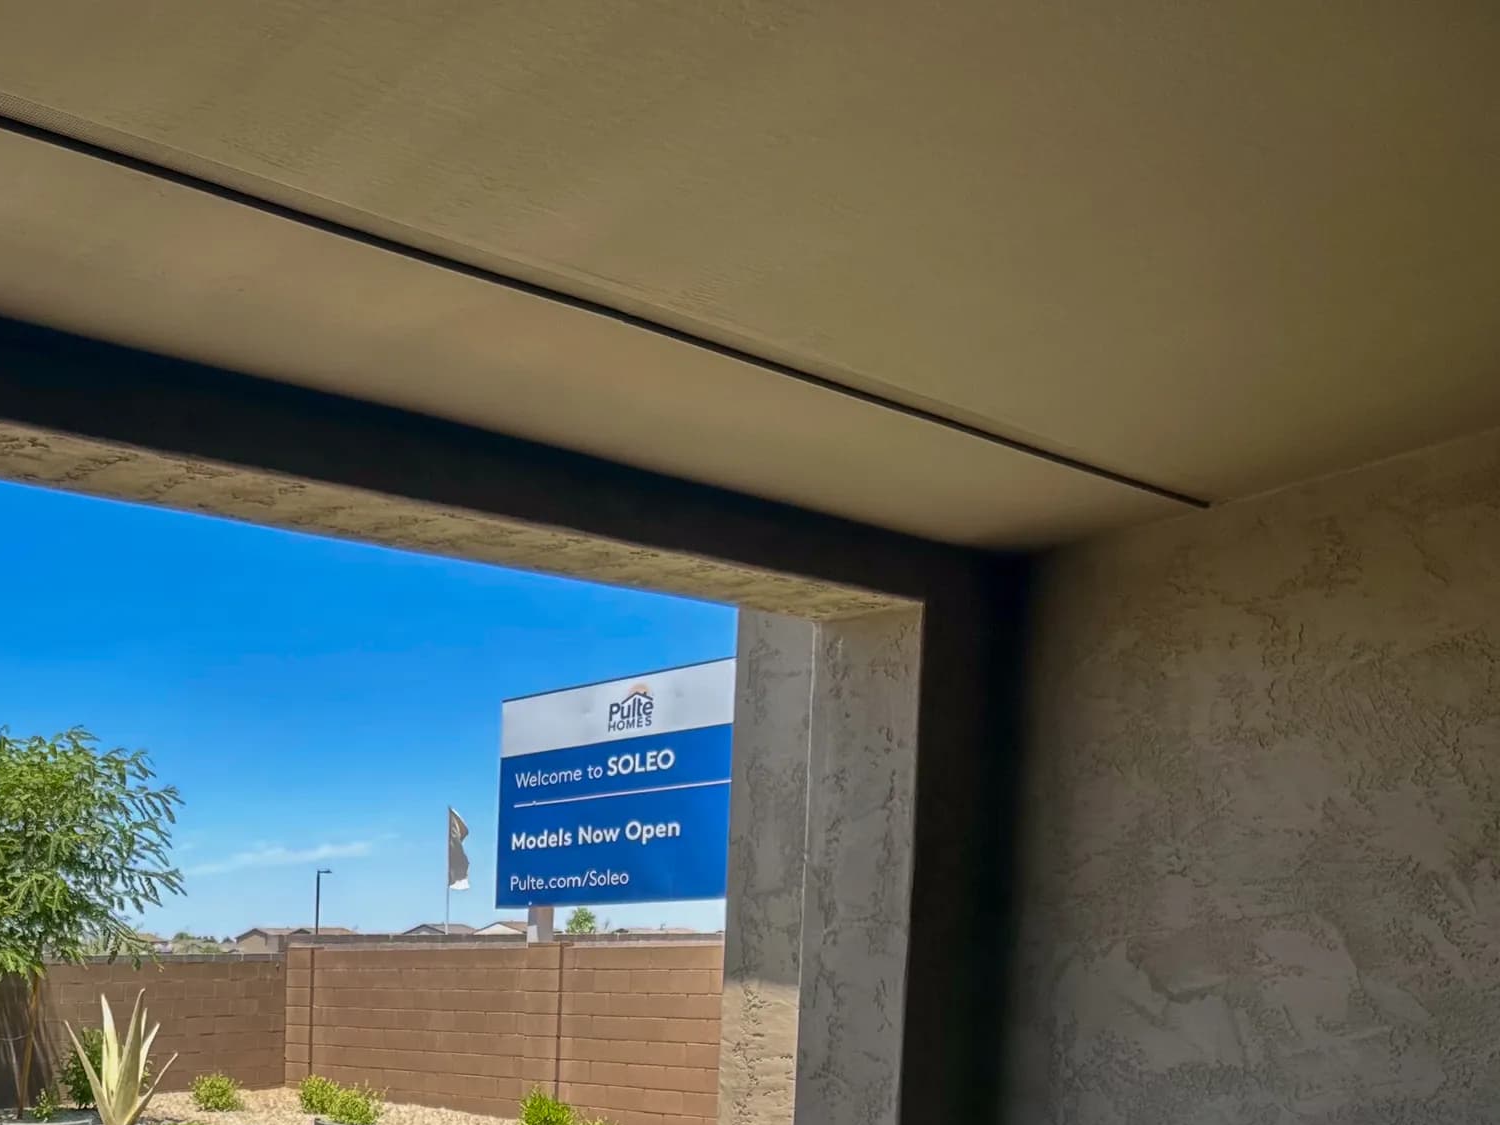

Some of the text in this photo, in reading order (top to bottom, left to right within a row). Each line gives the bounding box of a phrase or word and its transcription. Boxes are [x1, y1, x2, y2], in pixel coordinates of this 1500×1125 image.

[608, 700, 654, 722] Pulte
[607, 716, 652, 732] HOMES
[515, 749, 675, 789] Welcome to SOLEO
[511, 821, 681, 851] Models Now Open
[510, 869, 629, 891] Pulte.com/Soleo
